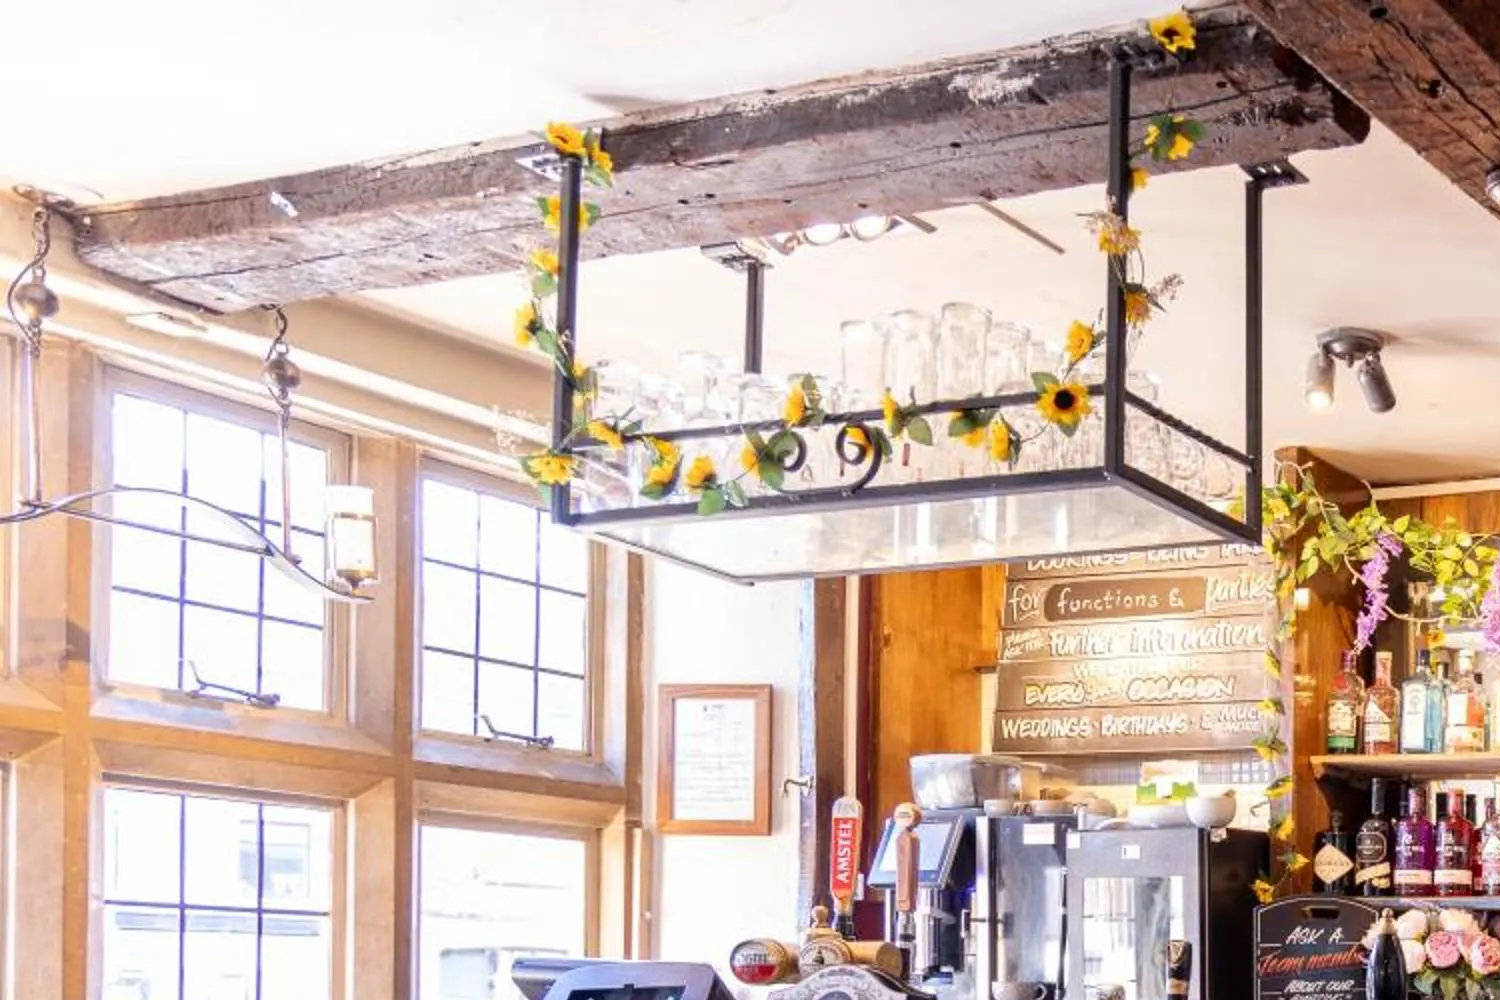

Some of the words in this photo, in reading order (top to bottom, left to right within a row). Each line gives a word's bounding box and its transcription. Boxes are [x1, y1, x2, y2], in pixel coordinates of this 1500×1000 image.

[1057, 586, 1160, 615] functions
[1168, 588, 1187, 608] &
[1002, 716, 1091, 739] WEDDINGS
[1100, 711, 1188, 736] BIRTHDAYS
[837, 822, 854, 883] AMSTEL
[1286, 926, 1325, 944] ASK
[1328, 927, 1345, 944] A
[1284, 980, 1324, 993] ABOUT
[1325, 979, 1355, 991] OUR
